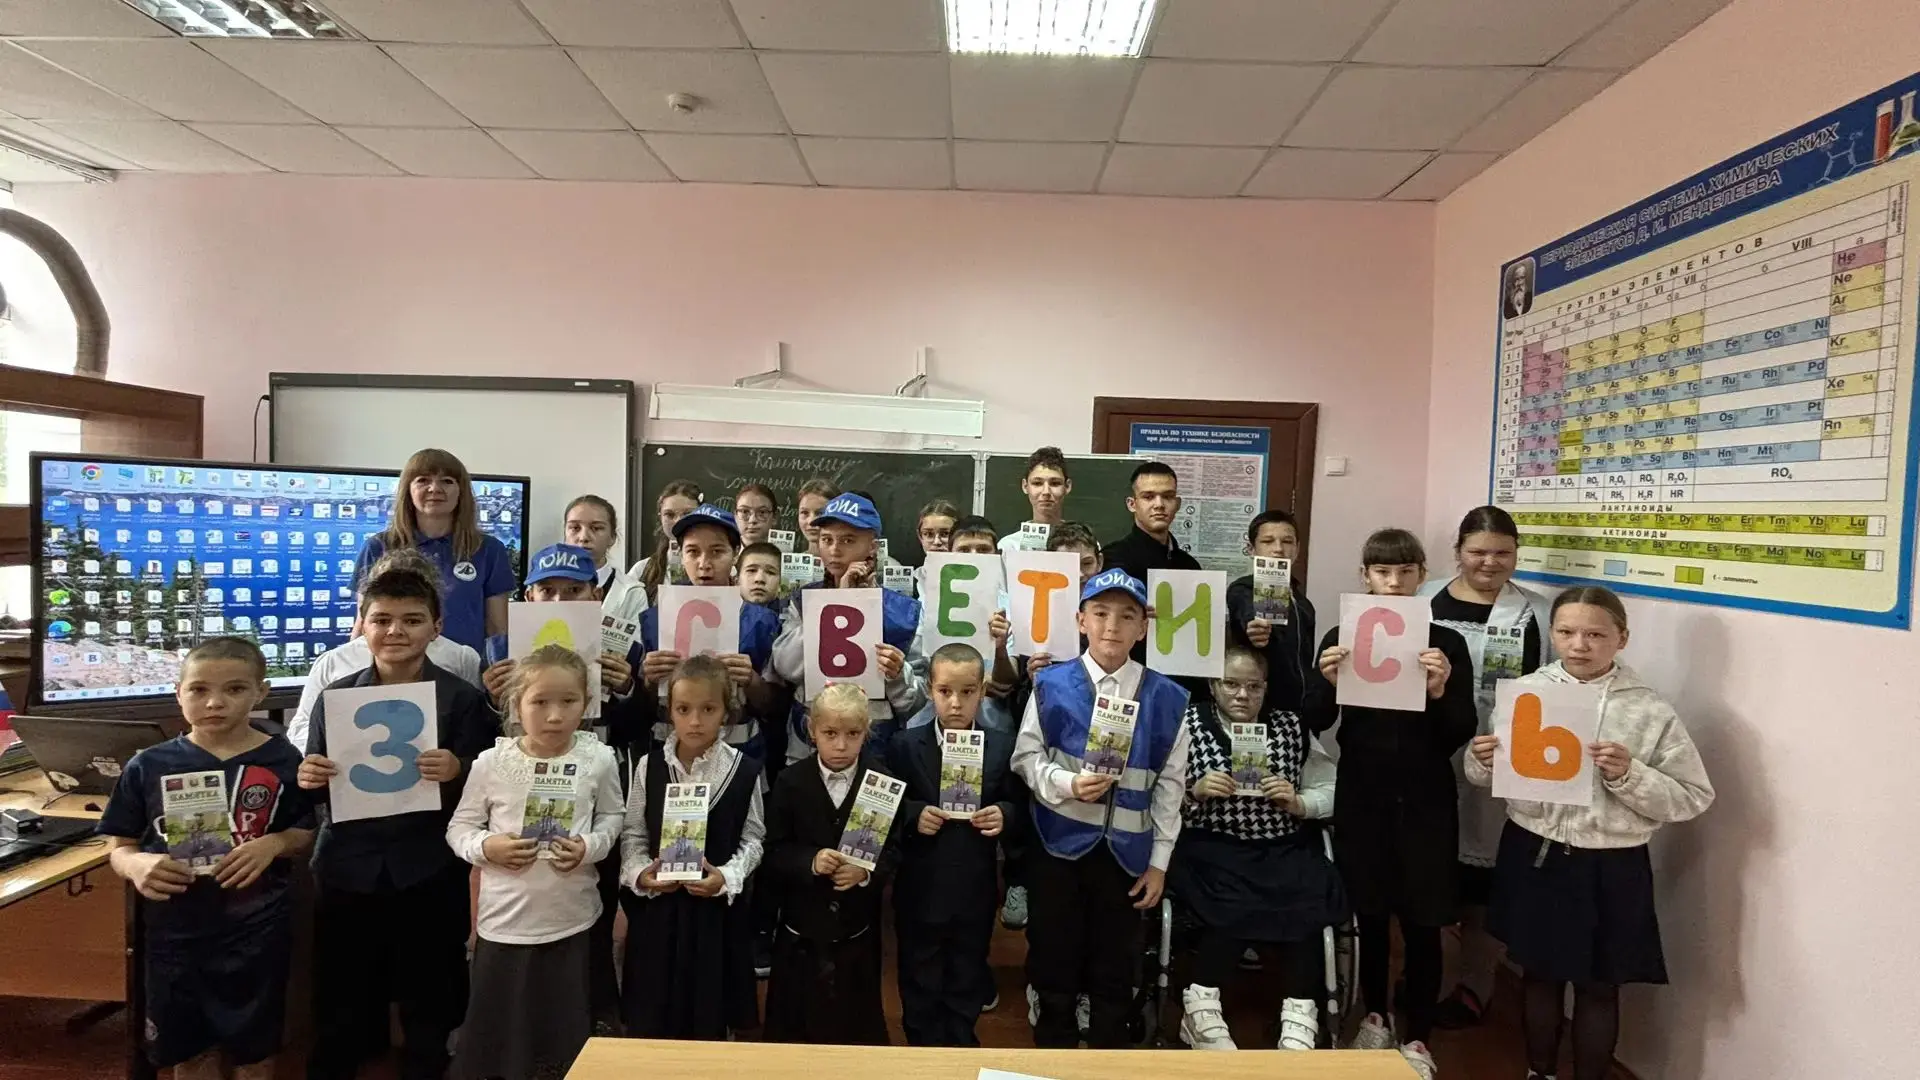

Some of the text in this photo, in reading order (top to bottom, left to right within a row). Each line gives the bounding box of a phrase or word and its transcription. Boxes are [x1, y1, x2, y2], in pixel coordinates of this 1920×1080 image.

[1539, 121, 1840, 267] ПЕРИОДИЧЕСКАЯ СИСТЕМА ХИМИЧЕСКИХ
[1564, 168, 1782, 271] ЭЛЕМЕНТОВ Д. И. МЕНДЕЛЕЕВА
[1683, 272, 1697, 286] VII
[1792, 237, 1813, 251] VIII
[1837, 251, 1856, 265] He
[1557, 236, 1763, 315] ГРУППЫ ЭЛЕМЕНТОВ
[1833, 272, 1852, 284] Ne
[1670, 334, 1679, 344] Cl
[1832, 295, 1846, 306] Ar
[1687, 347, 1701, 357] Mn
[1725, 339, 1739, 348] Fe
[1764, 330, 1780, 341] Co
[1814, 319, 1829, 330] Ni
[1669, 368, 1679, 377] Br
[1830, 335, 1846, 347] Kr
[1687, 383, 1698, 391] Tc
[1722, 376, 1735, 385] Ru
[1762, 369, 1777, 380] Rh
[1807, 360, 1825, 372] Pd
[1827, 379, 1845, 389] Xe
[1684, 417, 1697, 425] Re
[1719, 412, 1734, 423] Os
[1766, 407, 1775, 417] Ir
[1807, 400, 1823, 412] Pt
[1140, 428, 1168, 436] ПРАВИЛА
[1211, 431, 1260, 439] БЕЗОПАСНОСТИ
[1664, 437, 1674, 445] At
[1824, 419, 1841, 430] Rn
[1650, 455, 1661, 463] Sg
[1682, 452, 1695, 460] Bh
[1717, 449, 1732, 458] Hn
[1757, 445, 1773, 455] Mt
[1670, 489, 1684, 498] HR
[1601, 504, 1673, 513] ЛАНТАНОИДЫ
[1680, 515, 1691, 525] Dy
[1707, 515, 1720, 524] Ho
[1740, 515, 1752, 524] Er
[1769, 515, 1786, 525] Tm
[1808, 516, 1824, 526] Yb
[1850, 516, 1865, 526] Lu
[1602, 529, 1668, 539] АКТИНОИДЫ
[539, 551, 580, 570] ЮИД
[1679, 541, 1690, 550] Cf
[1706, 543, 1718, 552] Es
[1735, 544, 1750, 553] Fm
[1767, 547, 1784, 556] Md
[1805, 549, 1822, 558] No
[1851, 550, 1865, 561] Lr
[1095, 572, 1136, 592] ЮИД
[937, 563, 979, 637] Е
[1017, 569, 1069, 643] Т
[1156, 581, 1211, 657] И
[818, 603, 867, 678] В
[1353, 606, 1406, 683] С
[534, 777, 572, 787] ПАМЯТКА
